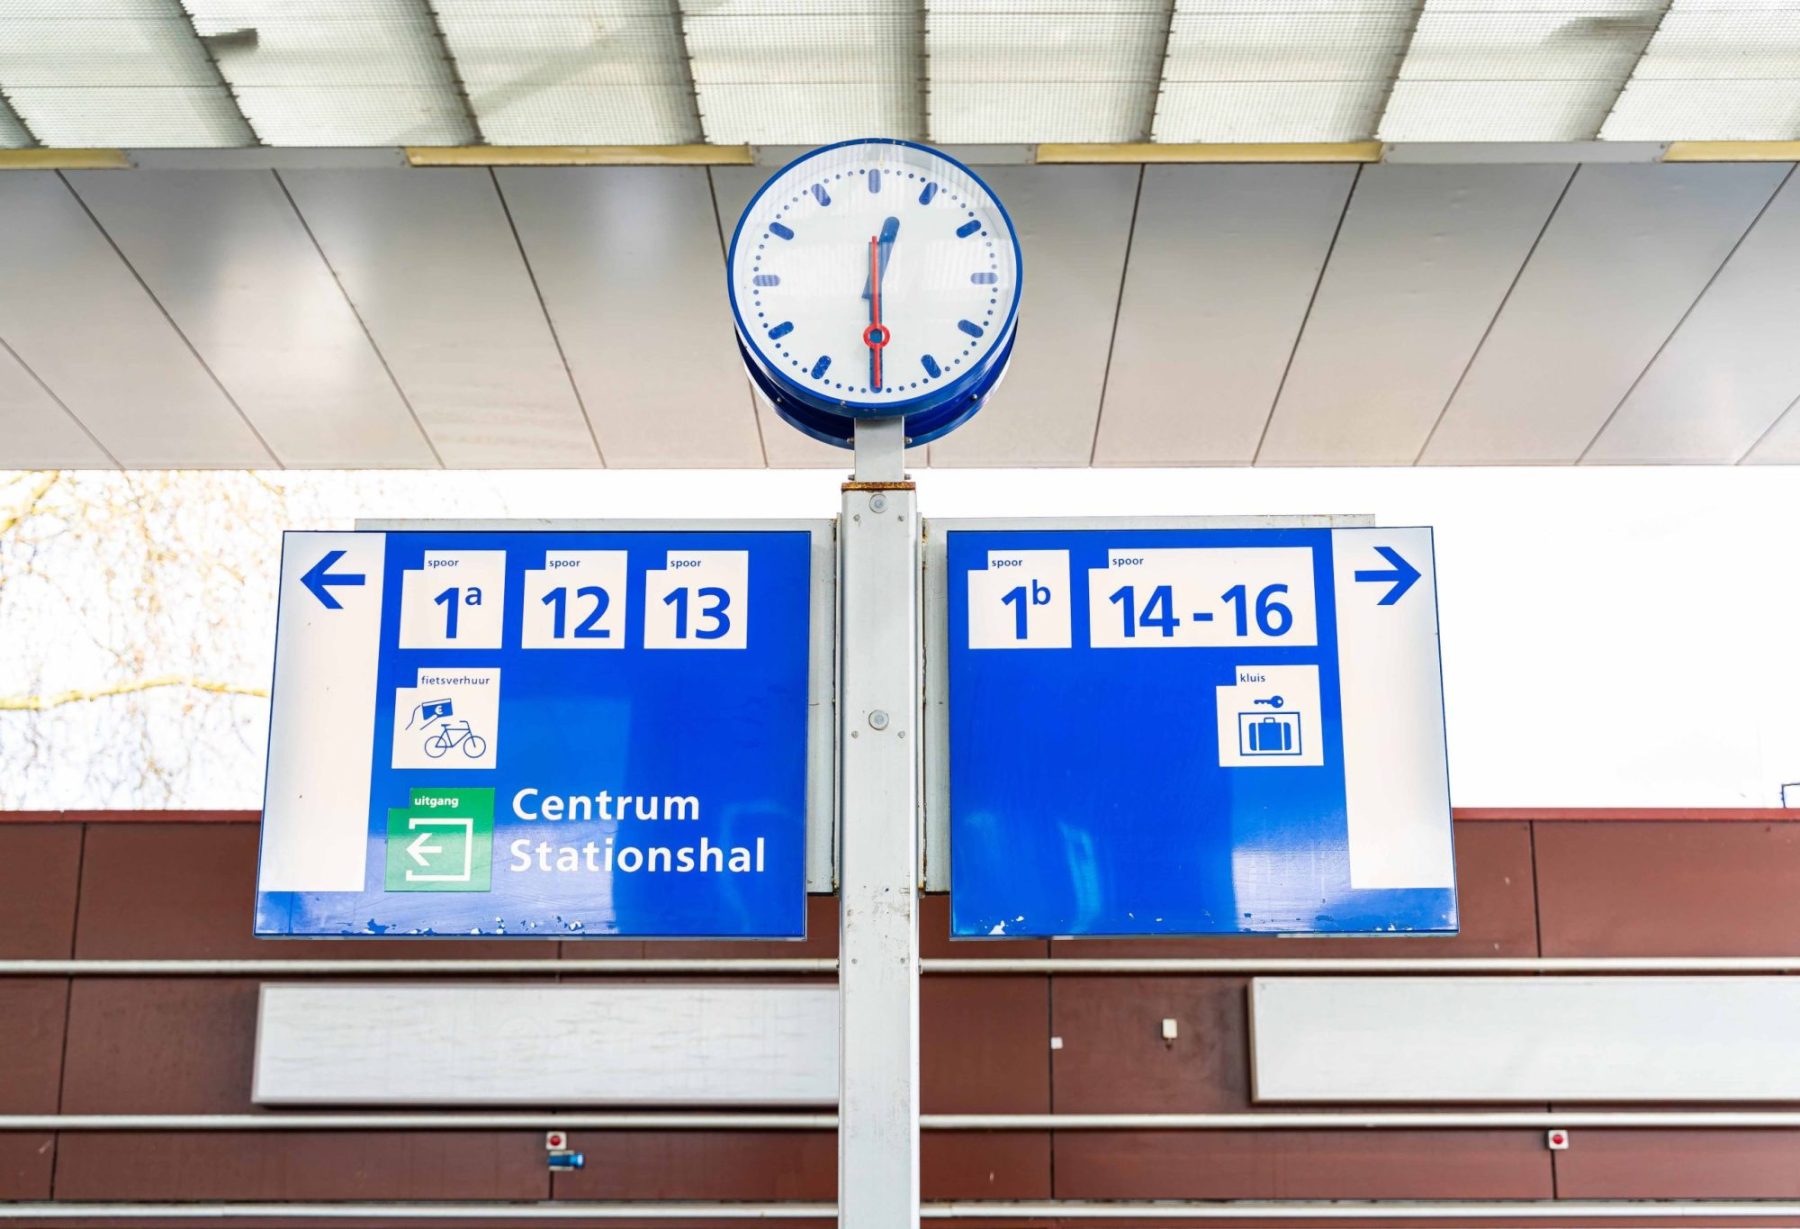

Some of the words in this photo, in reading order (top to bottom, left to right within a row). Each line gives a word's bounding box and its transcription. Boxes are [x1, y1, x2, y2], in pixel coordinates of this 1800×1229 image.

[427, 558, 460, 569] spoor
[549, 559, 581, 570] spoor
[670, 559, 702, 570] spoor
[991, 559, 1023, 569] spoor
[1112, 557, 1145, 568] spoor
[541, 585, 611, 639] 12
[662, 586, 732, 640] 13
[420, 675, 491, 685] fietsverhuur
[1239, 673, 1266, 683] kluis
[414, 795, 460, 809] uitgang
[512, 787, 700, 822] Centrum
[510, 837, 765, 874] Stationshal
